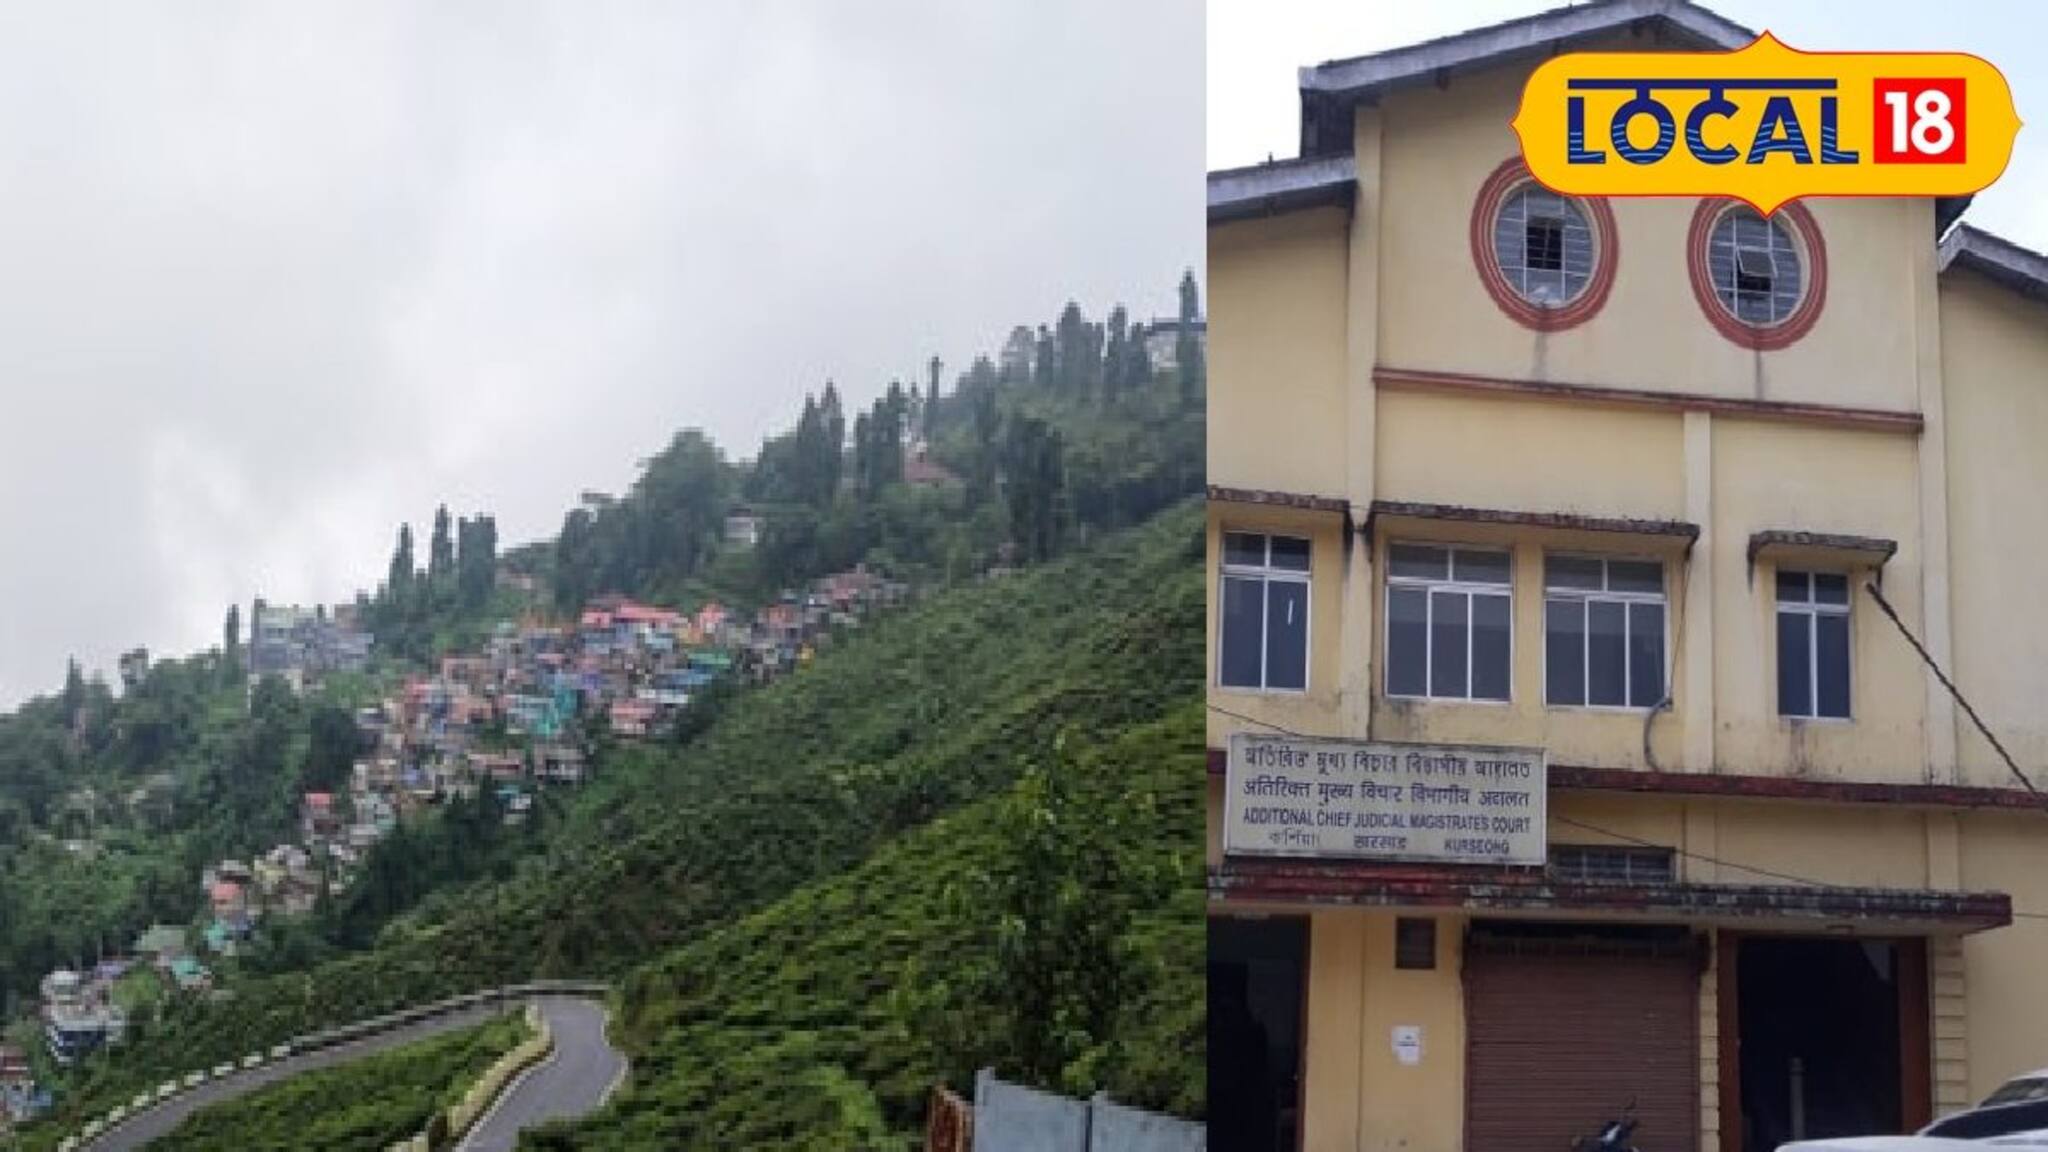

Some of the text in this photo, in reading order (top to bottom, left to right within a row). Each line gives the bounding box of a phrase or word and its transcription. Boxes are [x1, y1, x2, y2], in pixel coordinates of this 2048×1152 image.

[1316, 810, 1352, 828] CHIEF
[1491, 816, 1531, 834] COURT
[1444, 838, 1510, 855] KURSEONG
